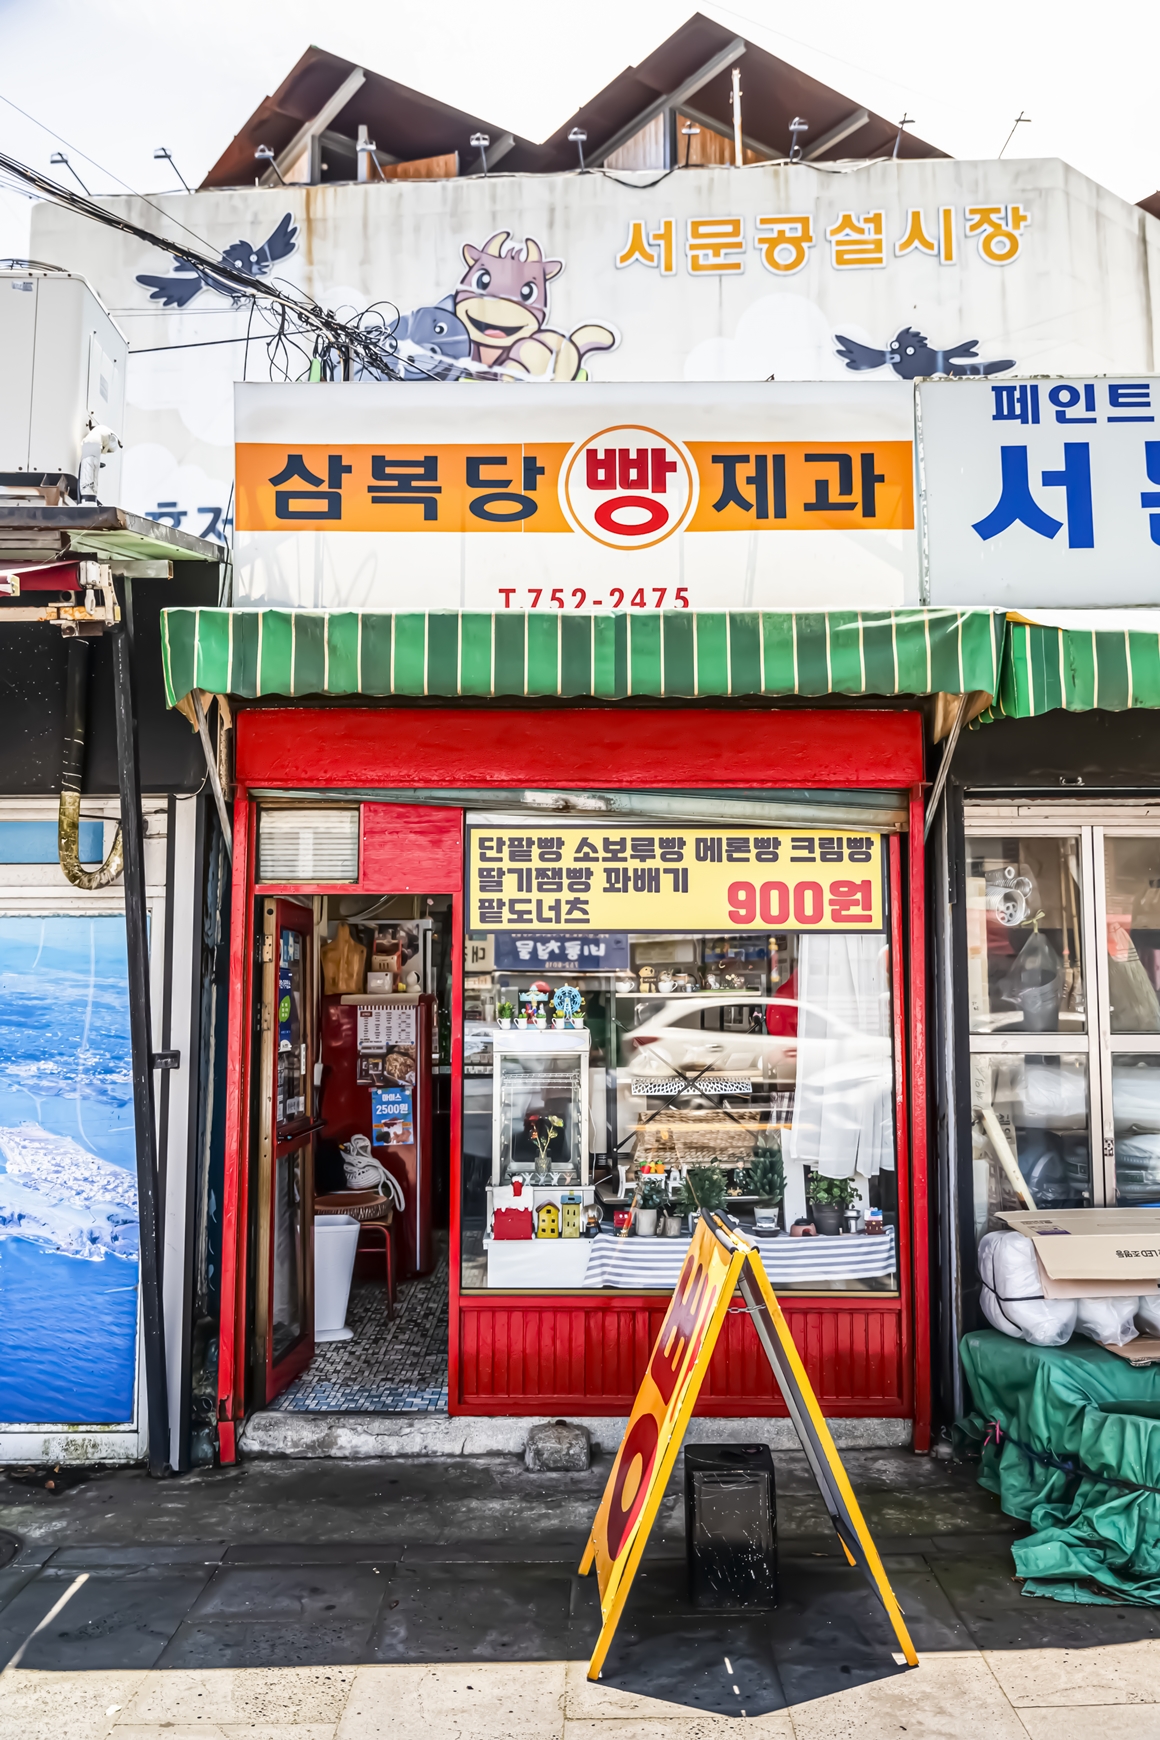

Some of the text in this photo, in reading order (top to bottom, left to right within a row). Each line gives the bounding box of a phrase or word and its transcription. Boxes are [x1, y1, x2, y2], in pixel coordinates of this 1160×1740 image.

[616, 203, 1030, 274] 서문공설시장
[990, 383, 1155, 425] 페인트
[267, 453, 546, 522] 삼복당
[585, 447, 678, 536] 빵
[710, 452, 886, 520] 제과
[970, 440, 1160, 549] 서
[498, 587, 689, 608] T752-2475
[478, 836, 875, 863] 단팥빵 소보루빵 메론빵 크림빵
[478, 866, 689, 894] 딸기쨈빵 꽈배기
[478, 897, 591, 925] 팥도너츠
[727, 879, 873, 925] 900원
[375, 1103, 408, 1115] 2500원
